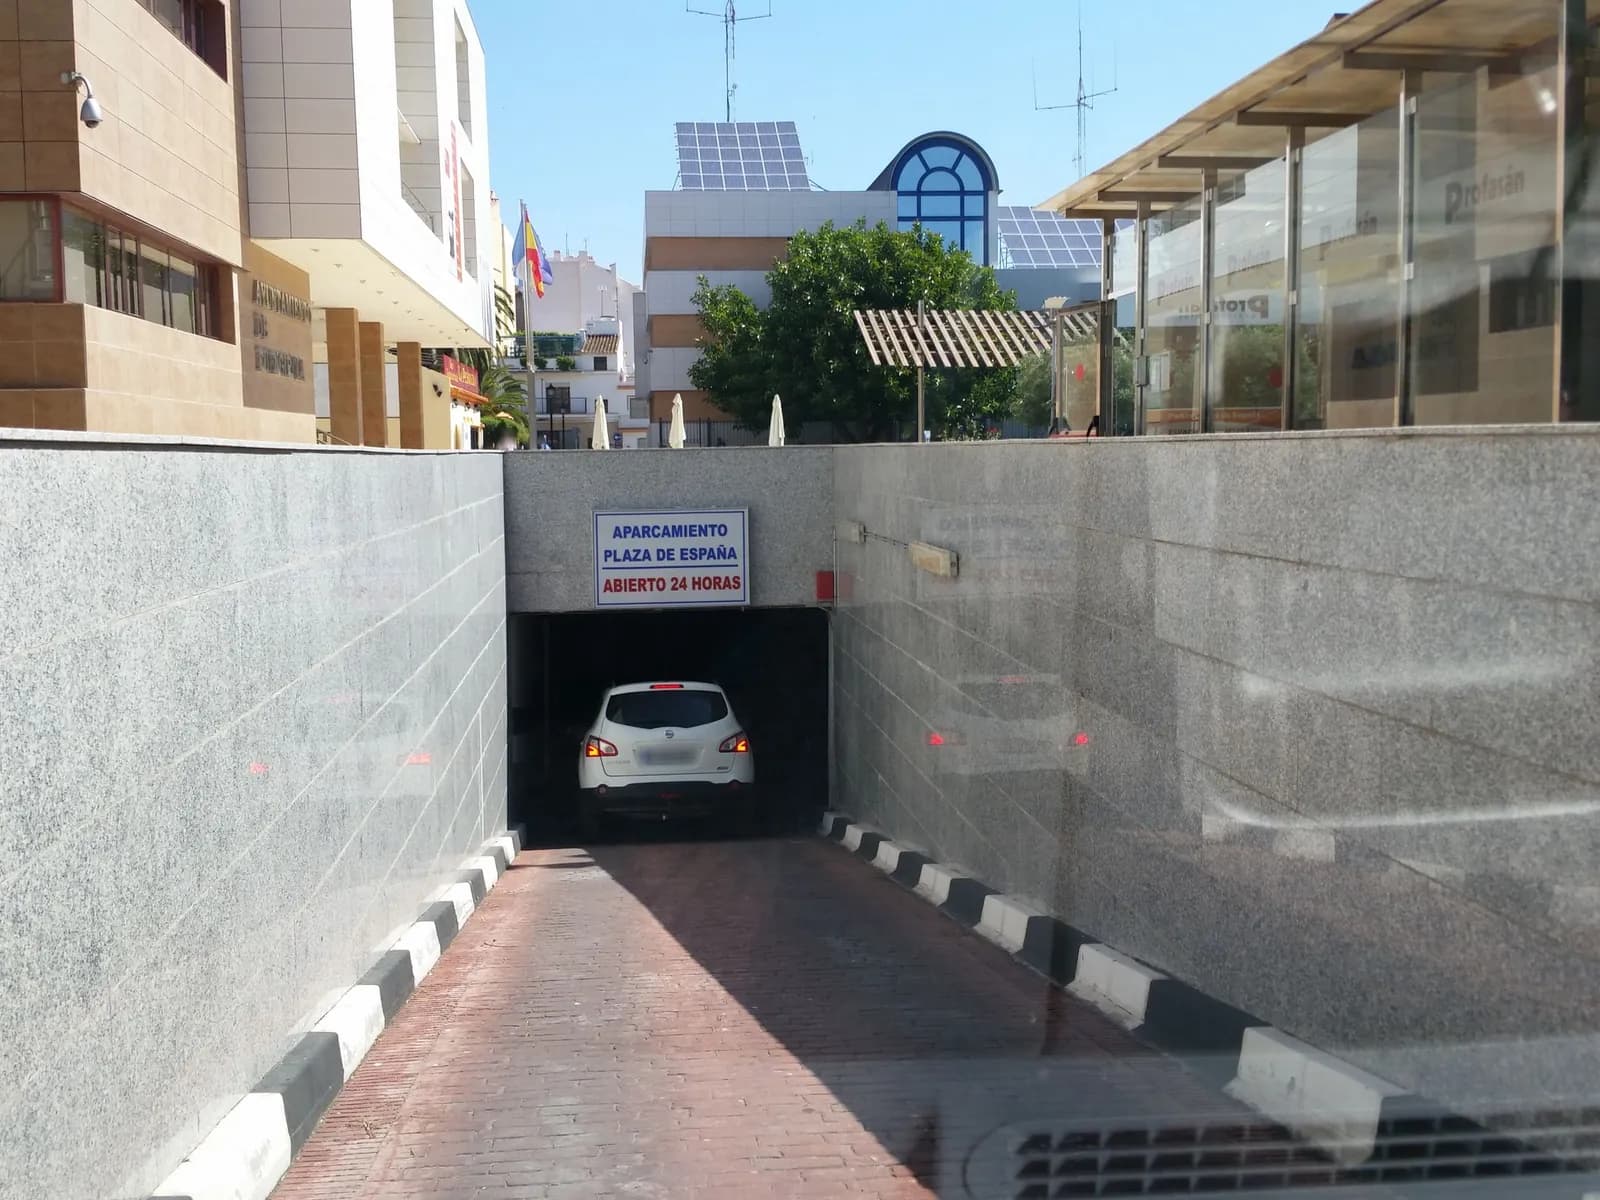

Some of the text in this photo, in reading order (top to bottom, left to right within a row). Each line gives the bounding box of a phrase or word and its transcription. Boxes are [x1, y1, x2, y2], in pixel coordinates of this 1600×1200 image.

[612, 523, 728, 539] APARCAMIENTO
[604, 544, 737, 562] PLAZA DE ESPAÑA
[603, 575, 741, 593] ABIERTO 24 HORAS
